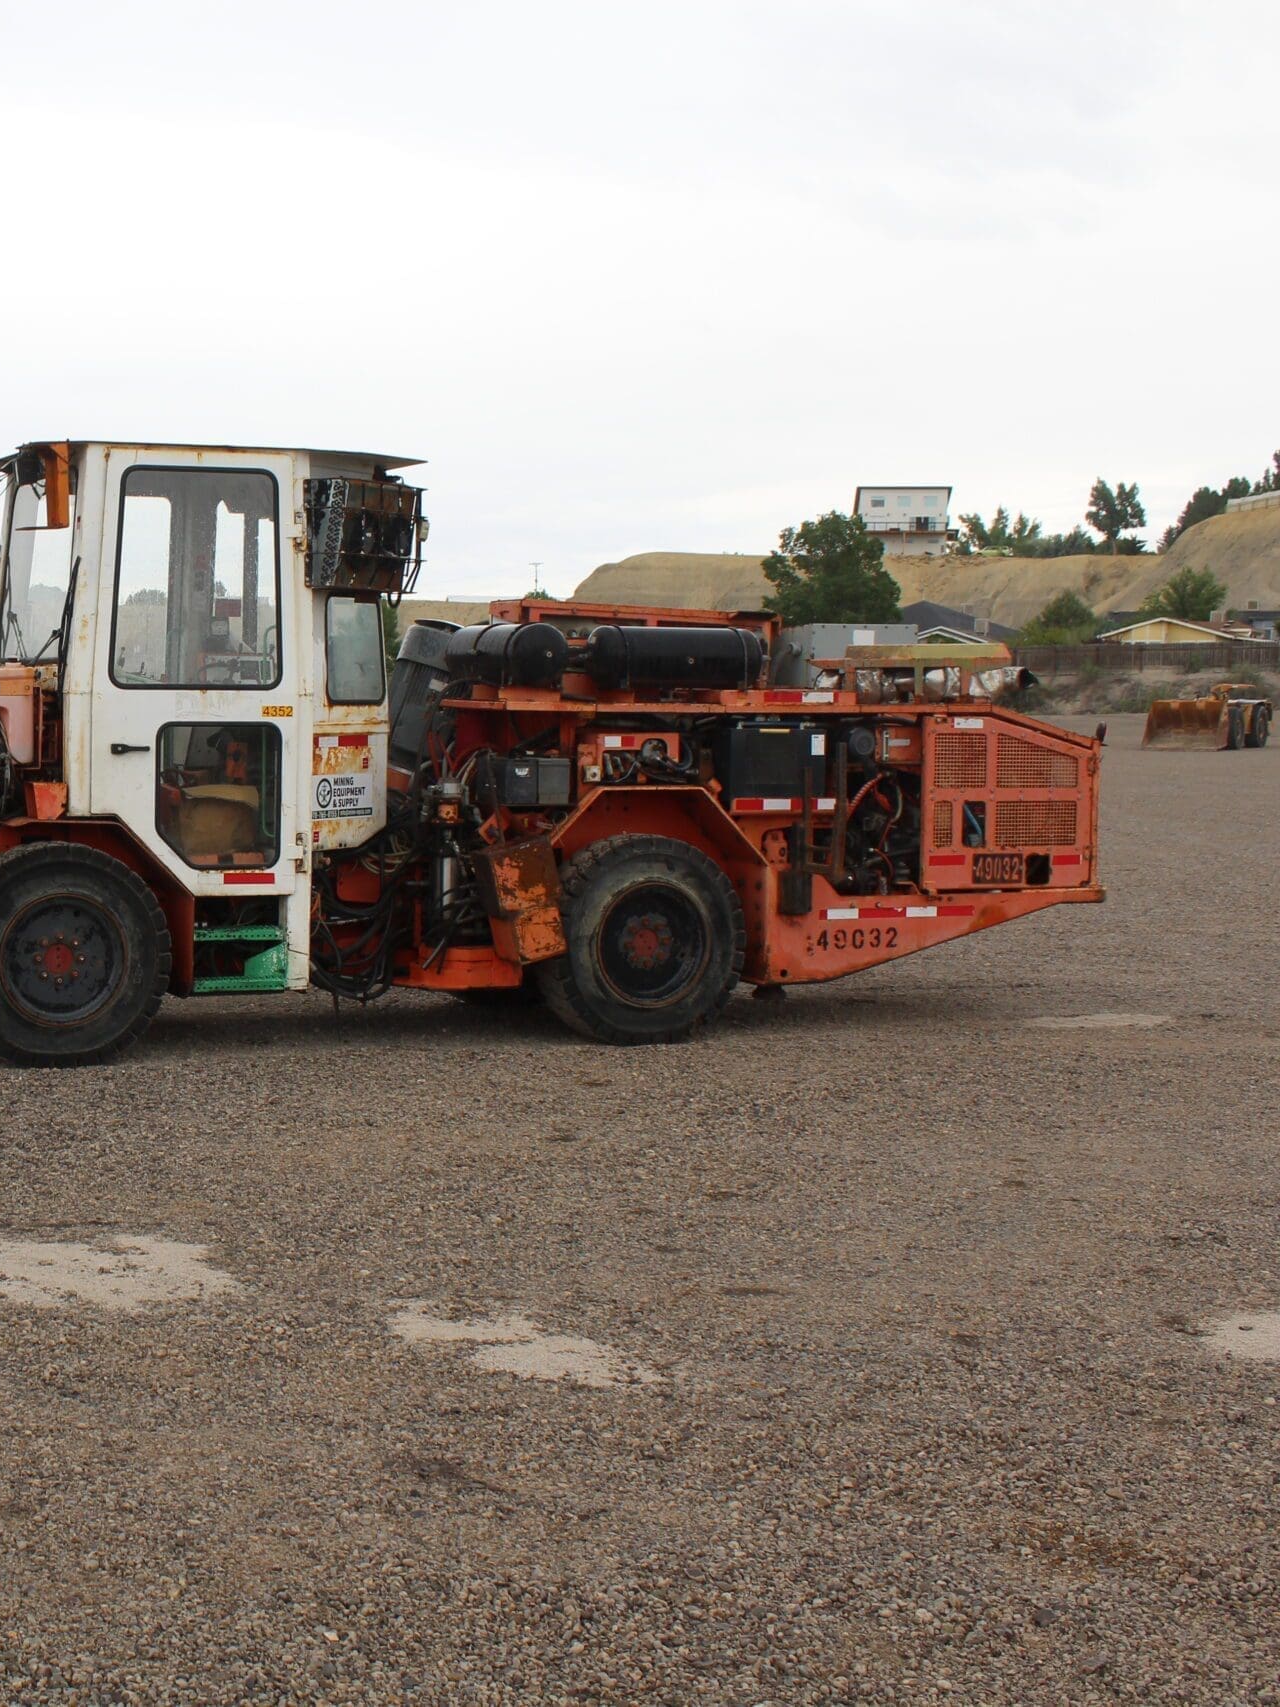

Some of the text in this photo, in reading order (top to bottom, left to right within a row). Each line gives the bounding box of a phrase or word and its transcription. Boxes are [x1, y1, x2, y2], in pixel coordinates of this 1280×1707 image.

[262, 705, 293, 717] 4352
[333, 777, 354, 786] MINING
[332, 787, 366, 797] EQUIPMENT
[332, 798, 359, 808] & SUPPLY
[976, 857, 1019, 880] 49032
[817, 926, 898, 951] 49032
